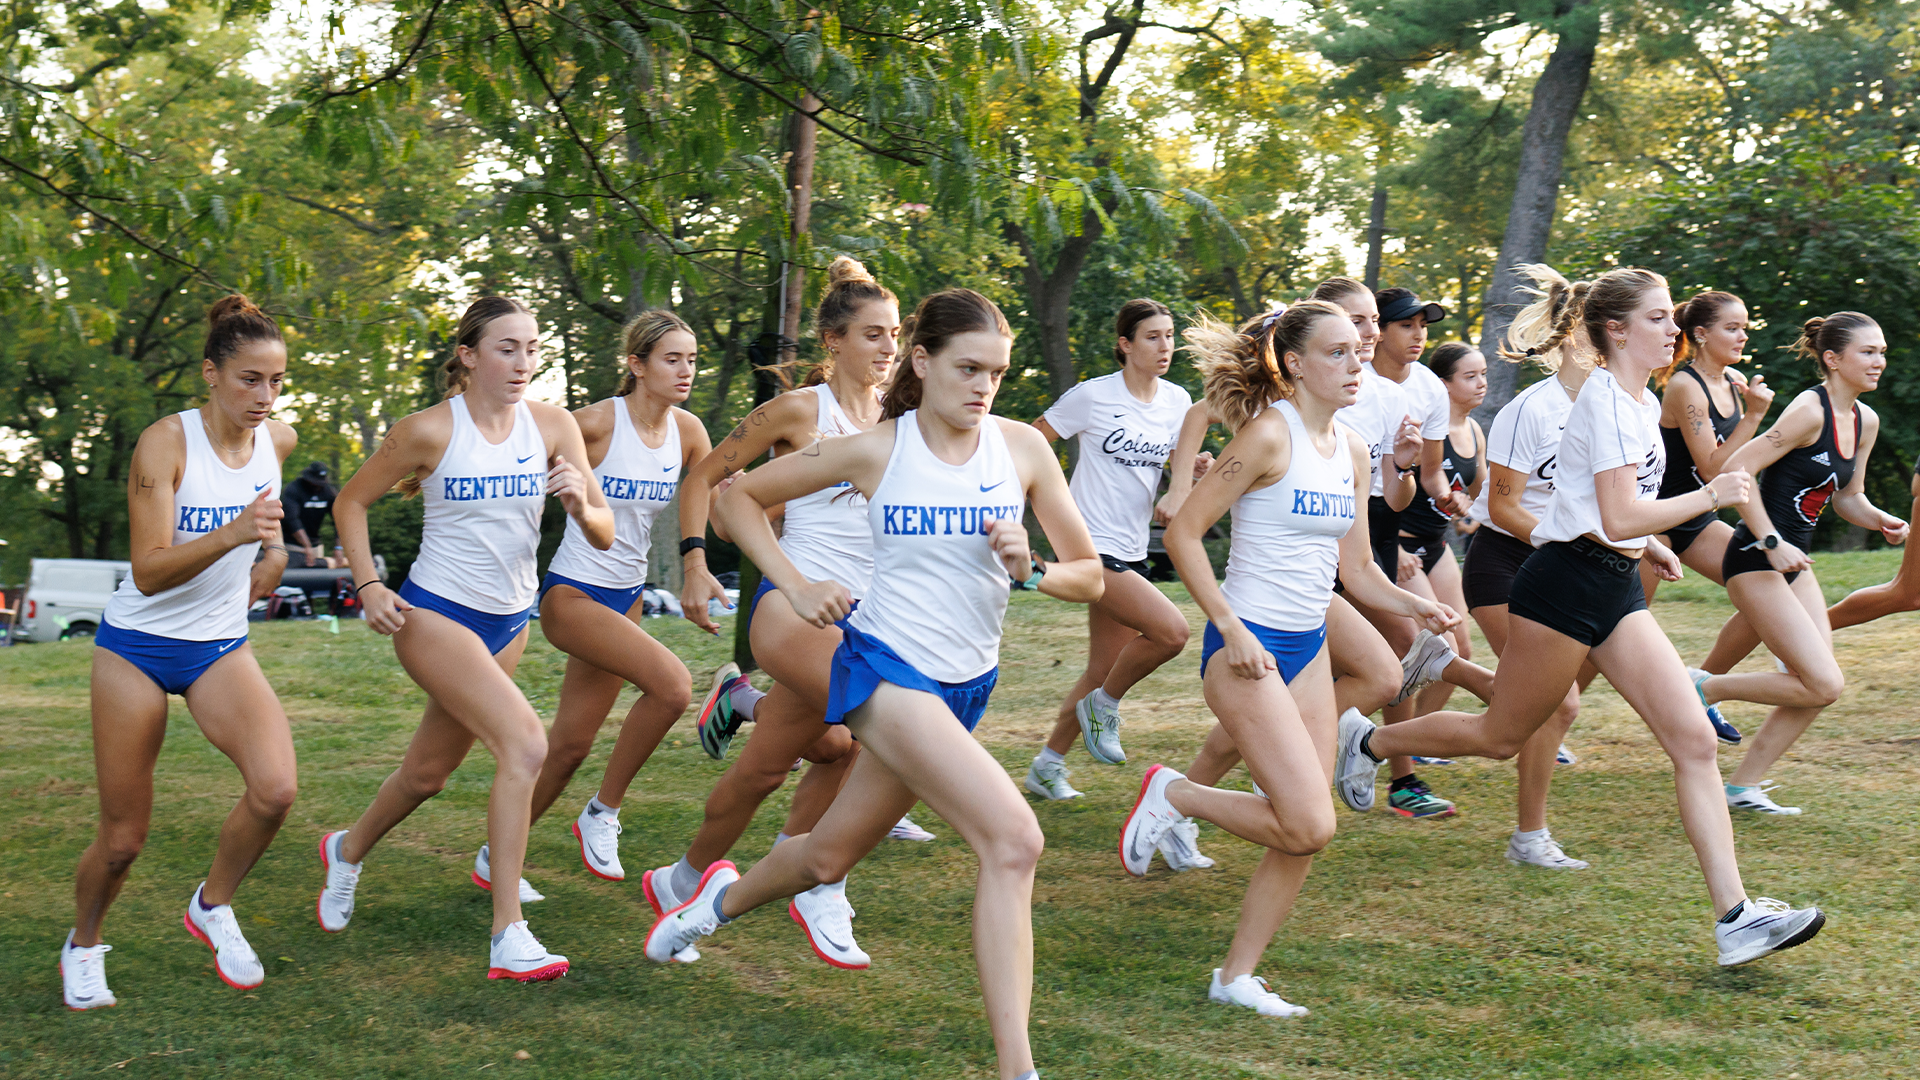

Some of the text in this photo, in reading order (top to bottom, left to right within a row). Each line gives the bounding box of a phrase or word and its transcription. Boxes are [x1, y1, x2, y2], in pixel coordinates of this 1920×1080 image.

[1687, 404, 1704, 420] 30
[1214, 455, 1243, 482] 18
[135, 473, 155, 496] 14
[1495, 478, 1511, 497] 40
[177, 504, 249, 533] KENT
[1587, 546, 1630, 573] PRO
